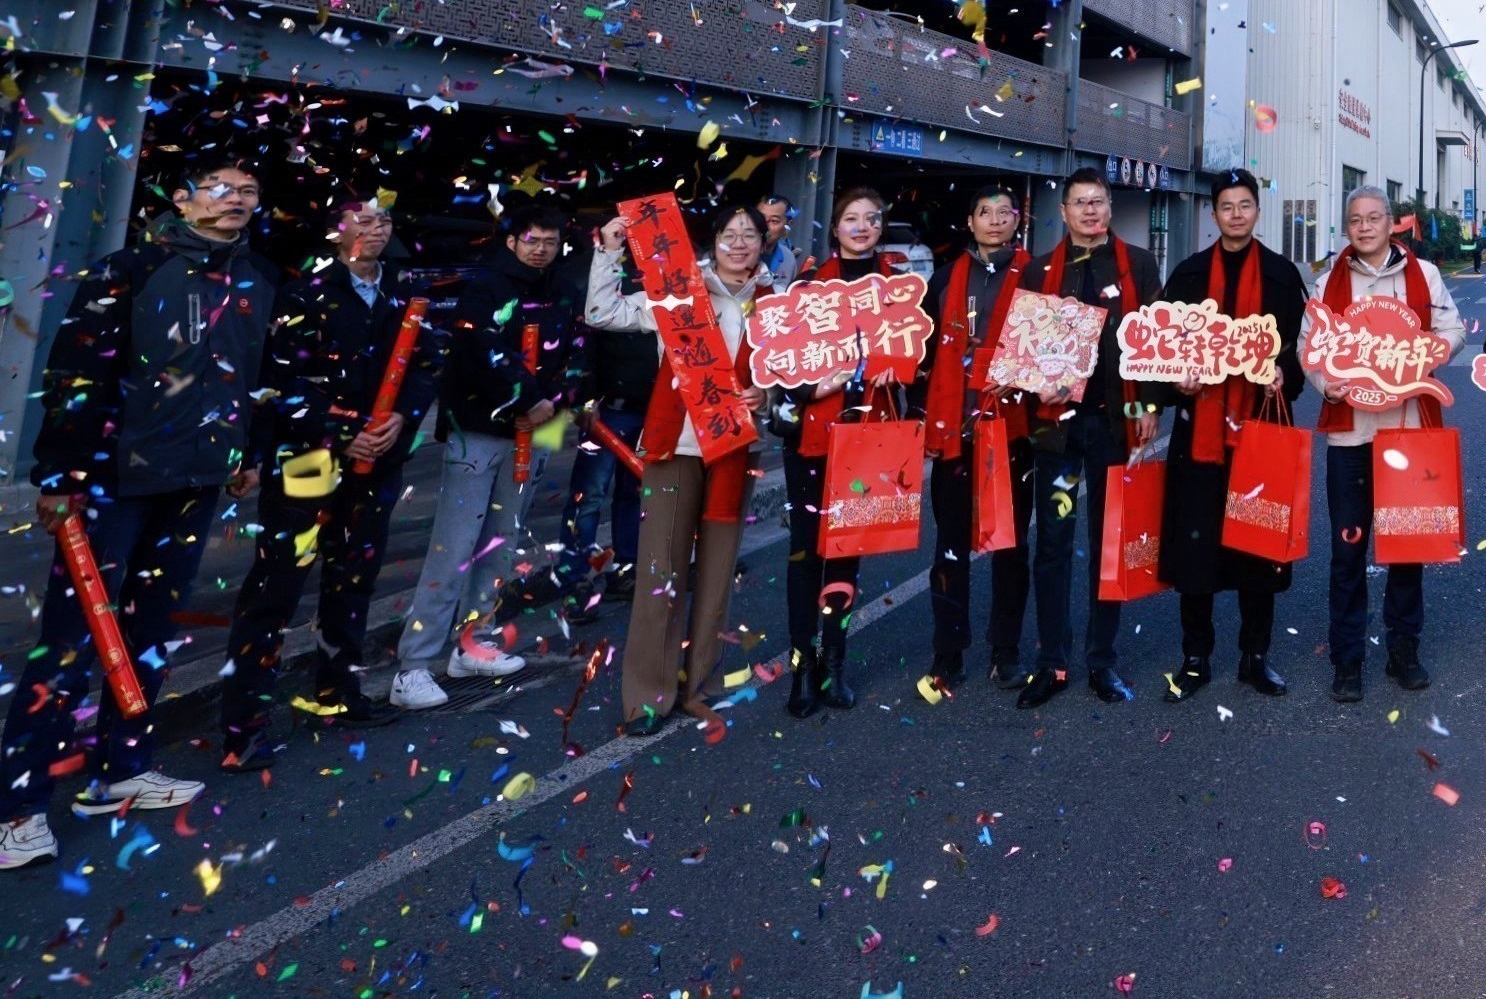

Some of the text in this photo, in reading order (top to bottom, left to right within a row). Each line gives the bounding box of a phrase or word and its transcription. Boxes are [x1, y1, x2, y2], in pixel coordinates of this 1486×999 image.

[758, 284, 916, 338] 聚智同心
[1349, 301, 1416, 329] HAPPY NEW YEAR
[763, 316, 923, 377] 向新而行
[1126, 364, 1213, 377] HAPPY NEW YEAR
[1355, 391, 1382, 403] 2025
